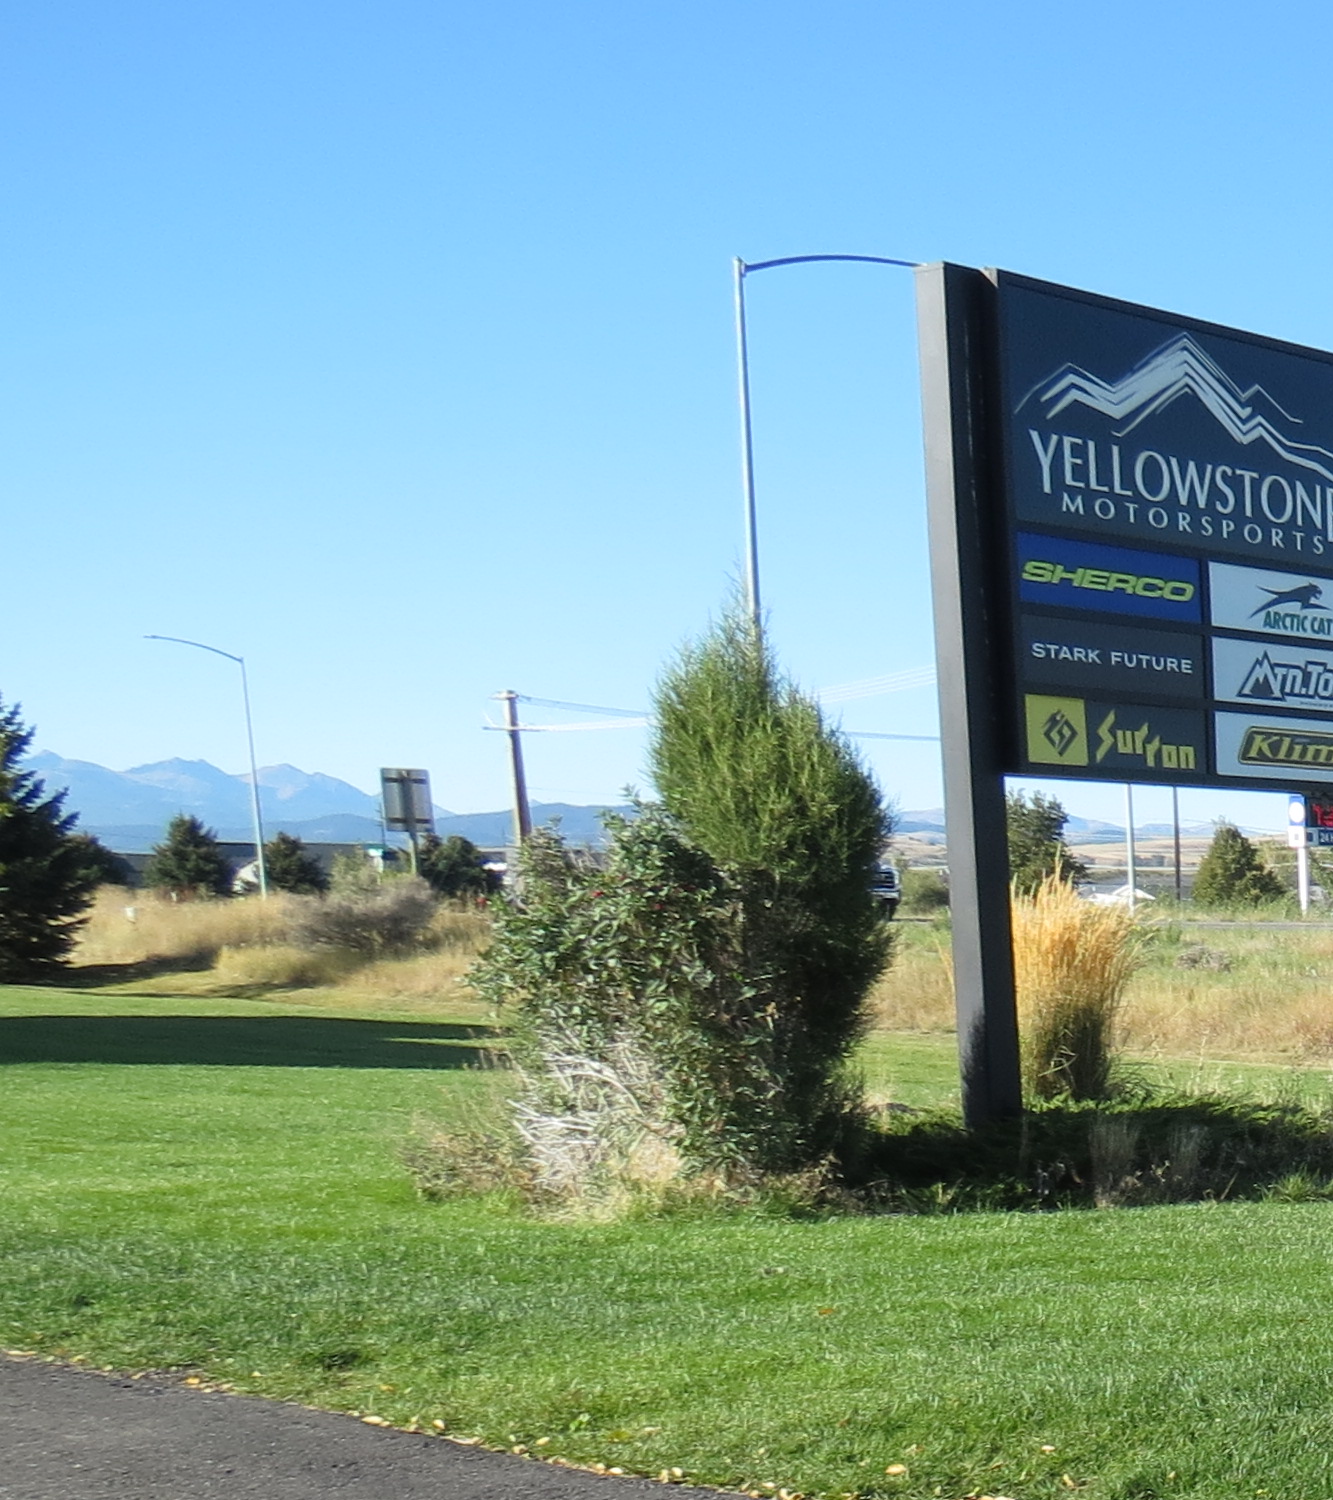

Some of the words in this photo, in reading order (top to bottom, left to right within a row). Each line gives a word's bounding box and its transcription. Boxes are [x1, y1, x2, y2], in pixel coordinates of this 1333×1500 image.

[1061, 492, 1324, 555] MOTORSPORTS
[1021, 560, 1195, 602] SHERCO
[1262, 610, 1308, 633] ARCTIC
[1310, 616, 1333, 636] CAT
[1032, 642, 1102, 664] STARK
[1111, 651, 1193, 674] FUTURE
